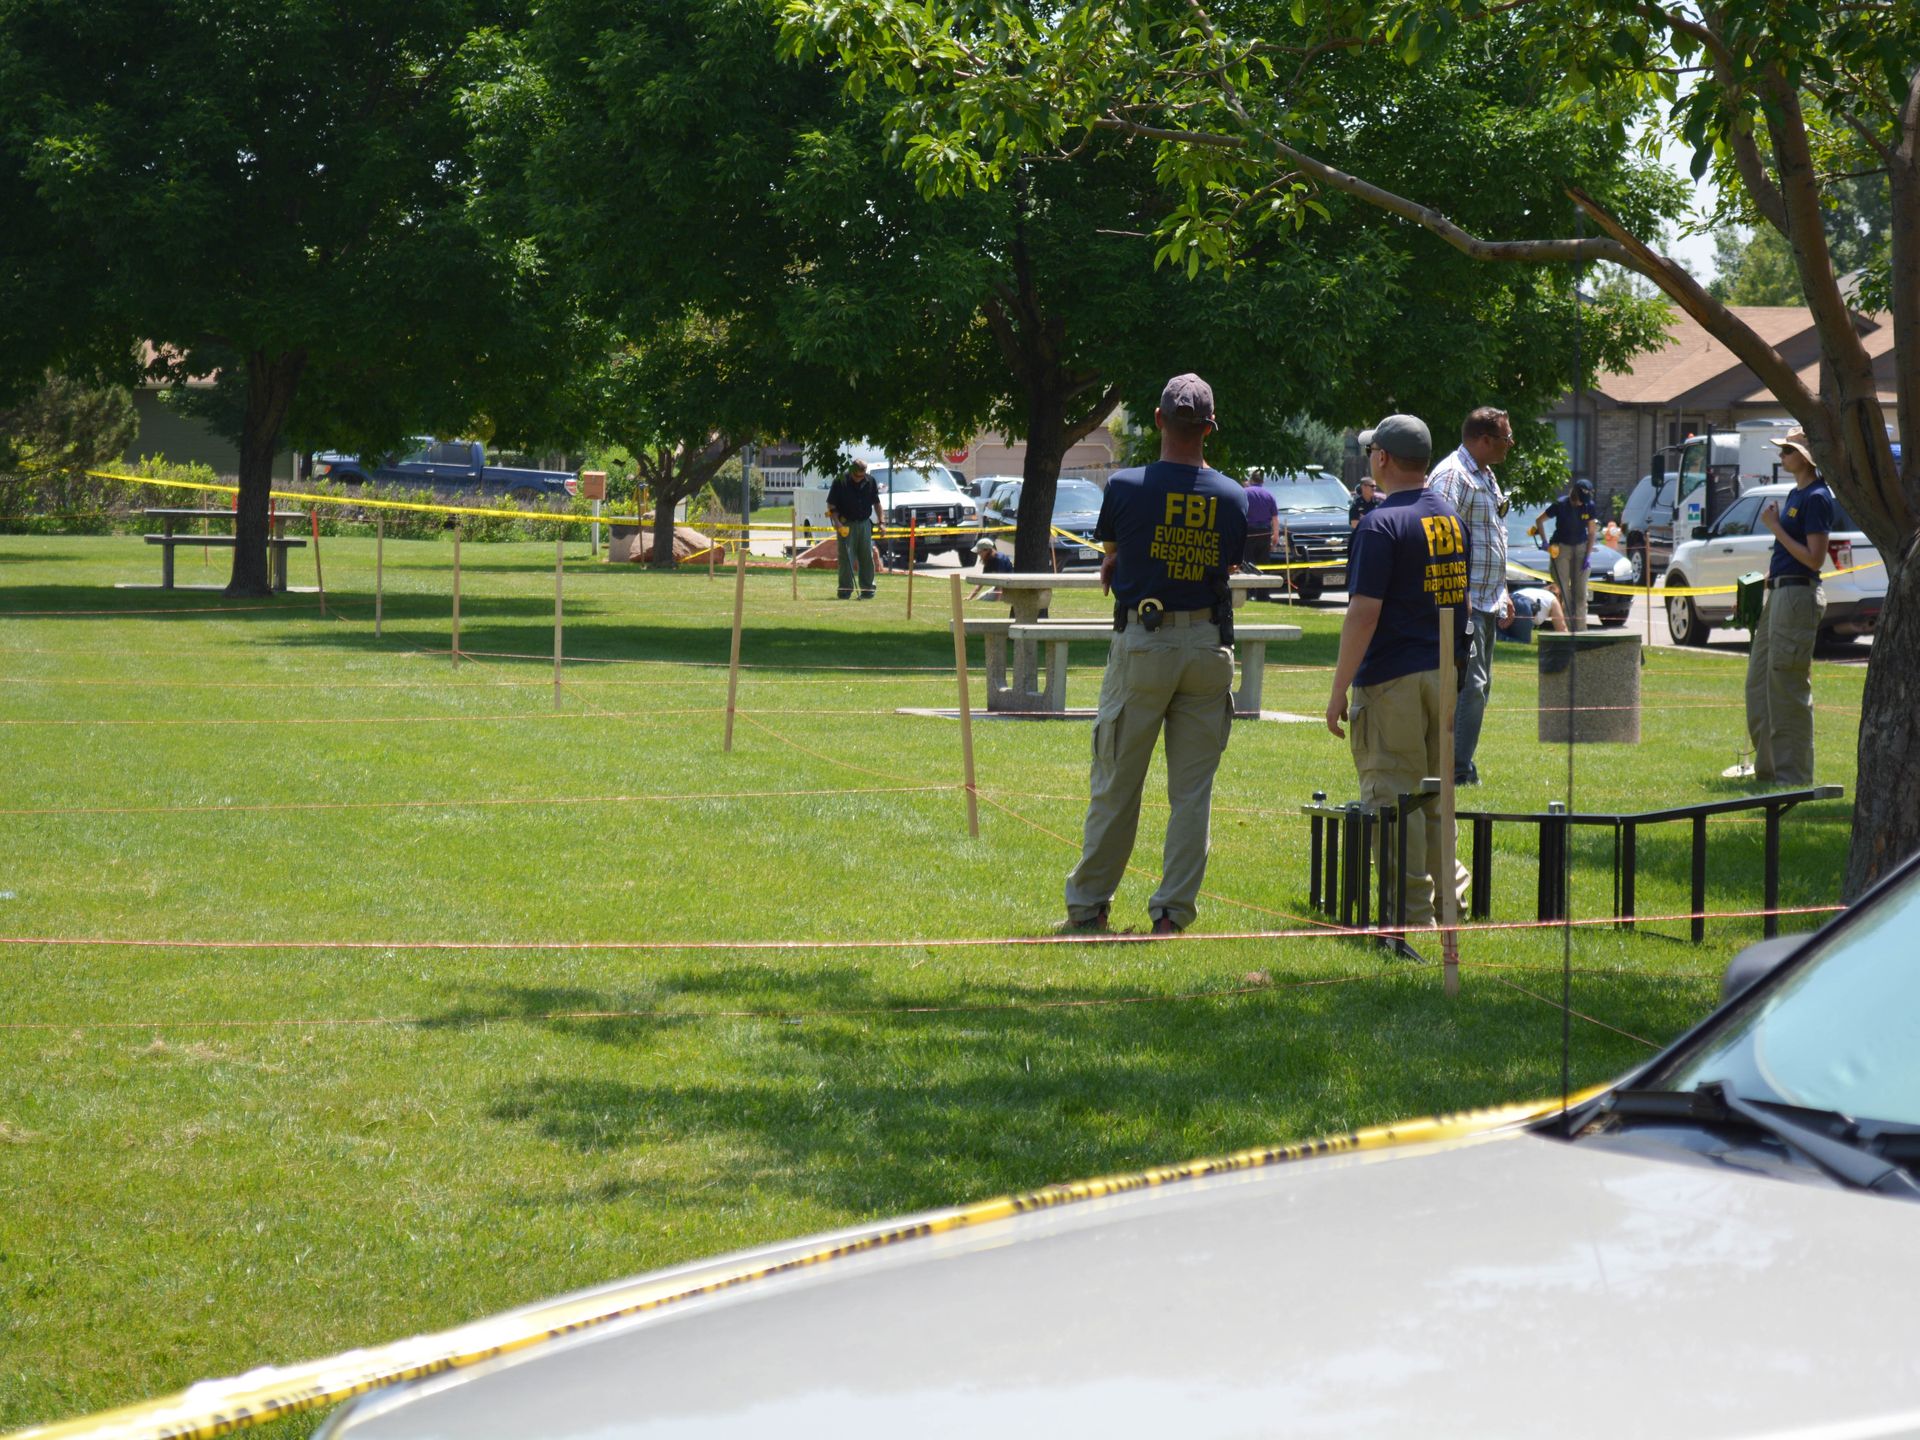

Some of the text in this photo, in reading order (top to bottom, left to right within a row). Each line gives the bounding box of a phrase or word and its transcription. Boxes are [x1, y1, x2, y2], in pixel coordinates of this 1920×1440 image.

[1165, 492, 1217, 529] FBI
[1154, 525, 1220, 548] EVIDENCE
[1421, 515, 1463, 557] FBI
[1150, 542, 1219, 567] RESPONSE
[1166, 561, 1205, 581] TEAM
[1423, 575, 1468, 592] RPONS
